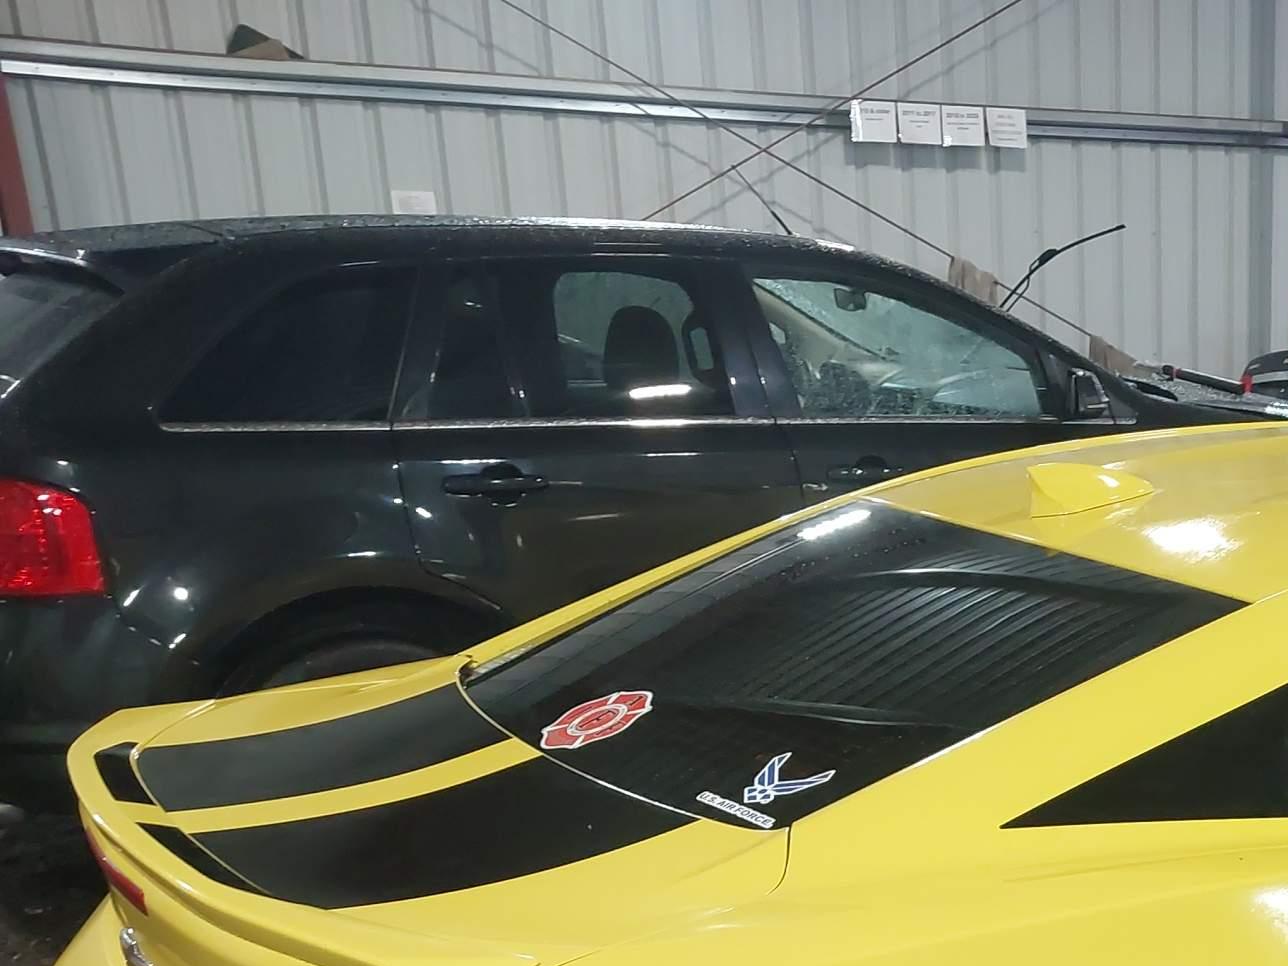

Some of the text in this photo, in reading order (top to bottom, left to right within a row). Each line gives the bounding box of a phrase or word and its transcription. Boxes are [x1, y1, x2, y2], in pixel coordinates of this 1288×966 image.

[699, 792, 773, 826] U.S. AIR FORCE
